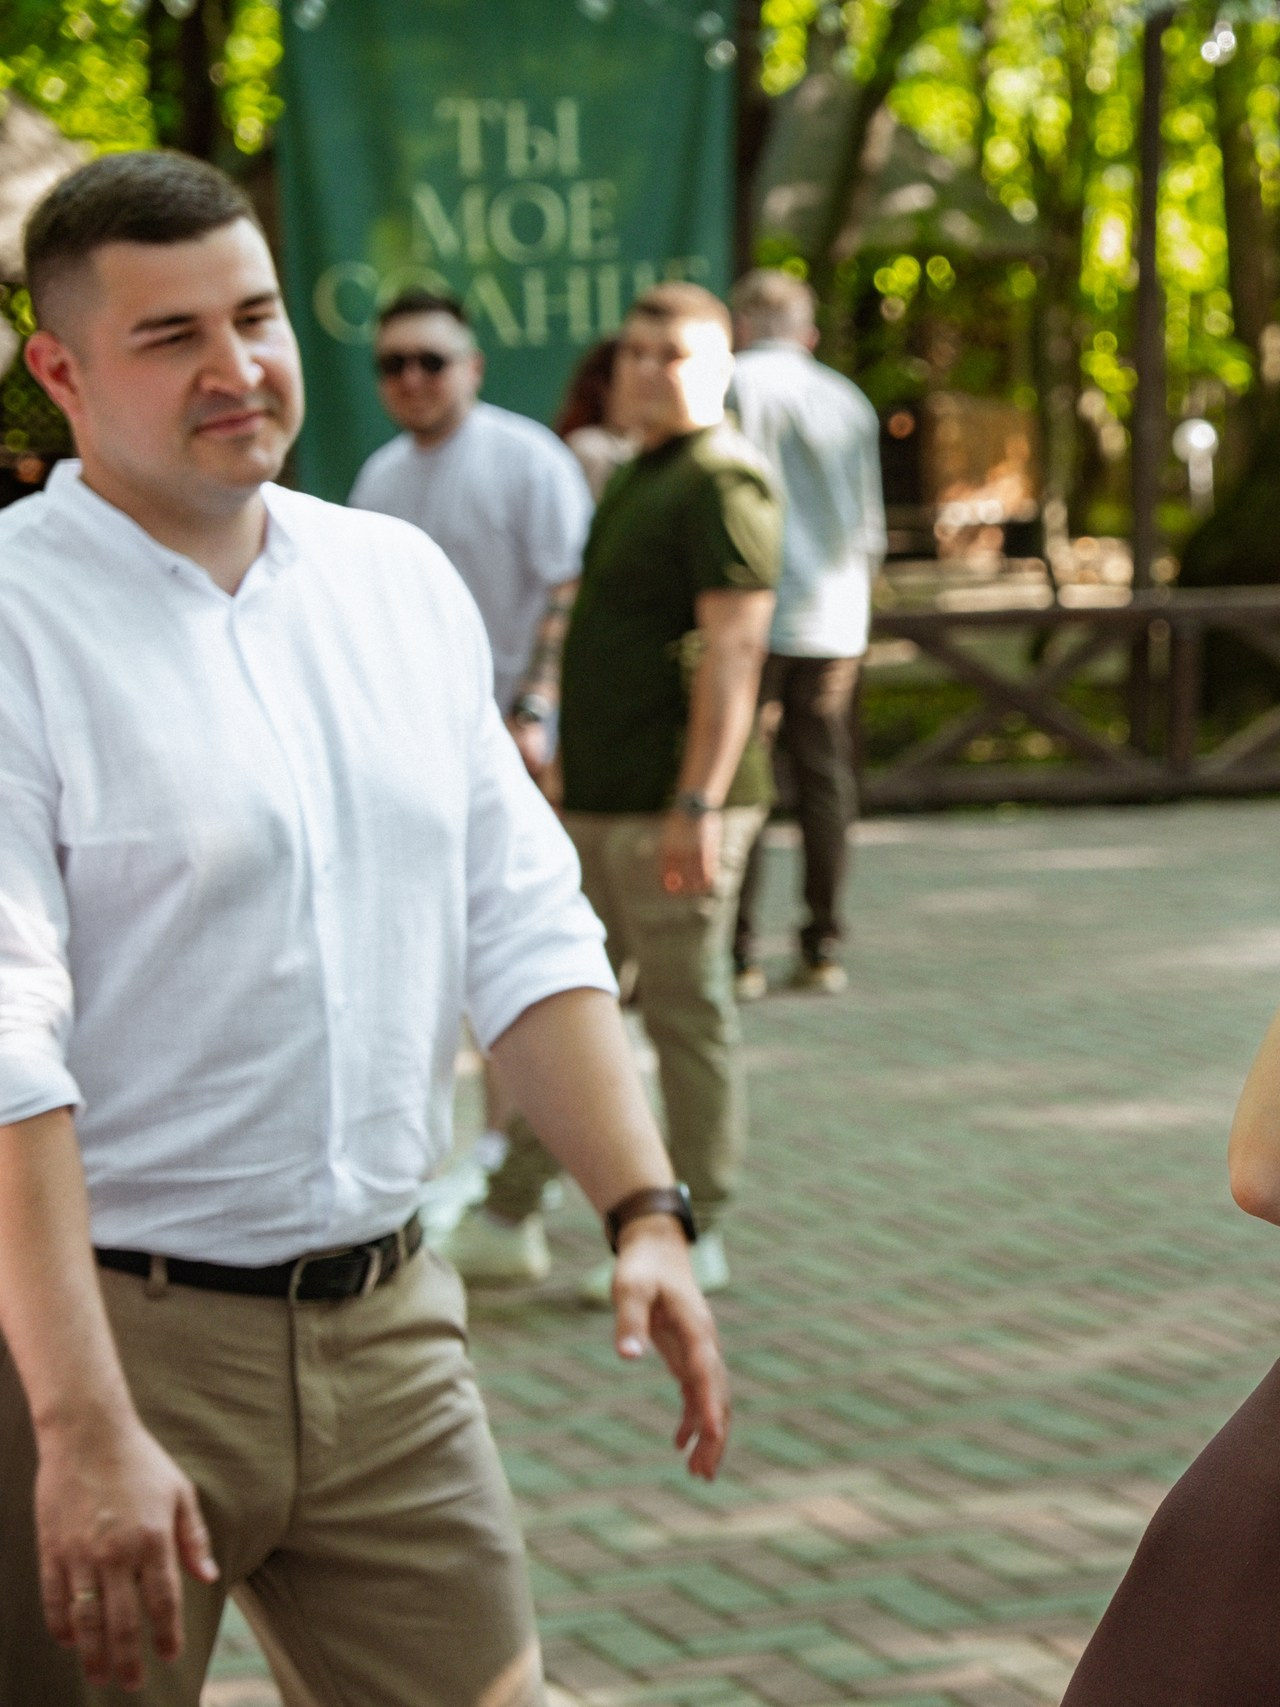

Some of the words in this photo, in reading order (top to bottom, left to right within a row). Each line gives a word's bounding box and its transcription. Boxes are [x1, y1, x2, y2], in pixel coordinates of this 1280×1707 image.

[433, 98, 582, 178] ТЫ
[410, 180, 620, 264] МОЕ
[313, 258, 711, 348] СЛН
